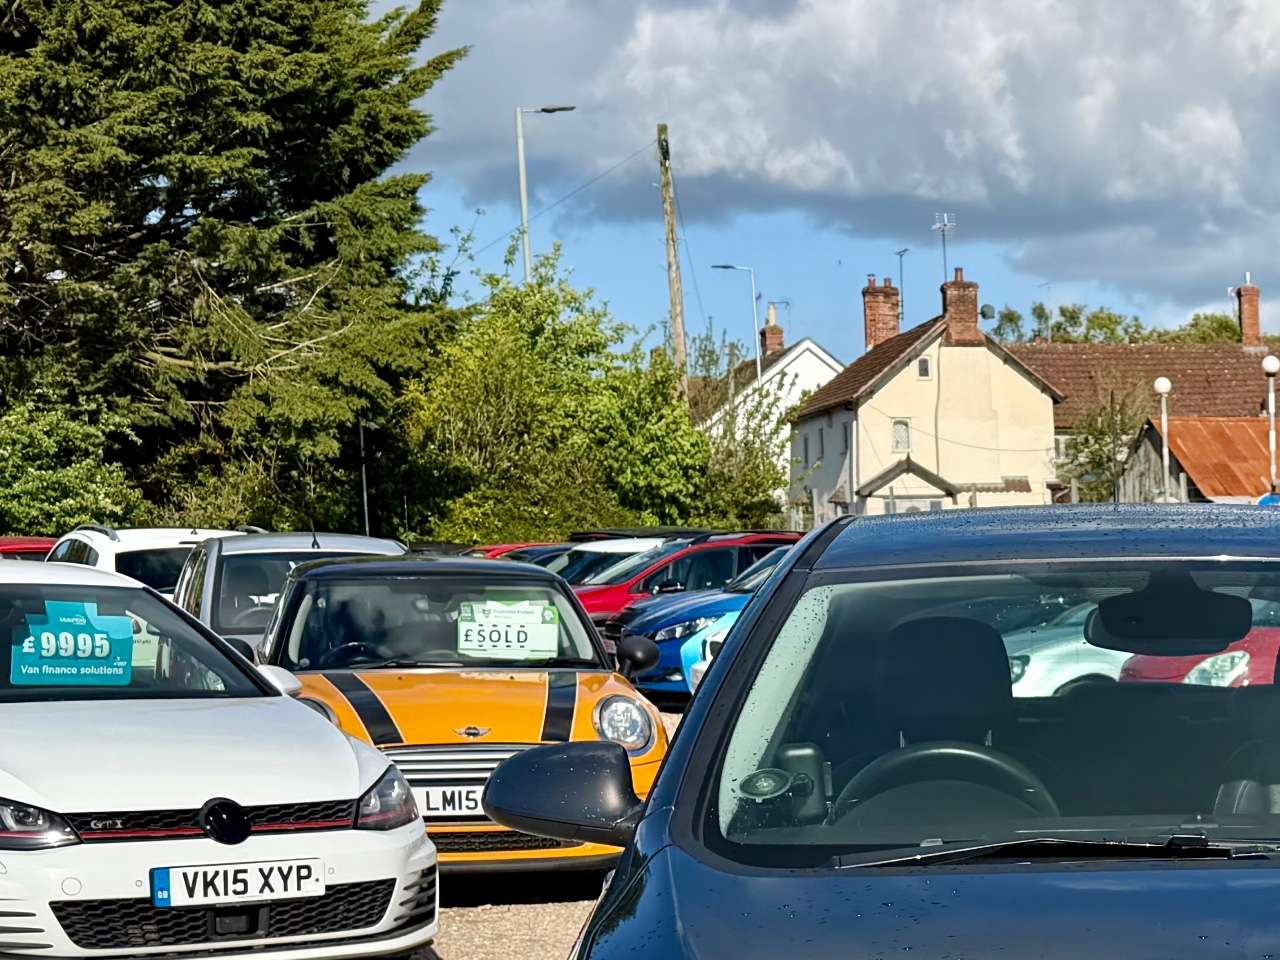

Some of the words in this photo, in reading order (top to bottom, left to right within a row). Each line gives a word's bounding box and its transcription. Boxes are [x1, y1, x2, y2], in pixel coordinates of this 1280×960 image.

[21, 665, 39, 674] Van
[42, 665, 77, 674] finance
[80, 666, 123, 675] solutions
[426, 790, 478, 811] LM15
[91, 820, 122, 829] GTI
[183, 869, 249, 898] VK15
[258, 865, 313, 894] XYP
